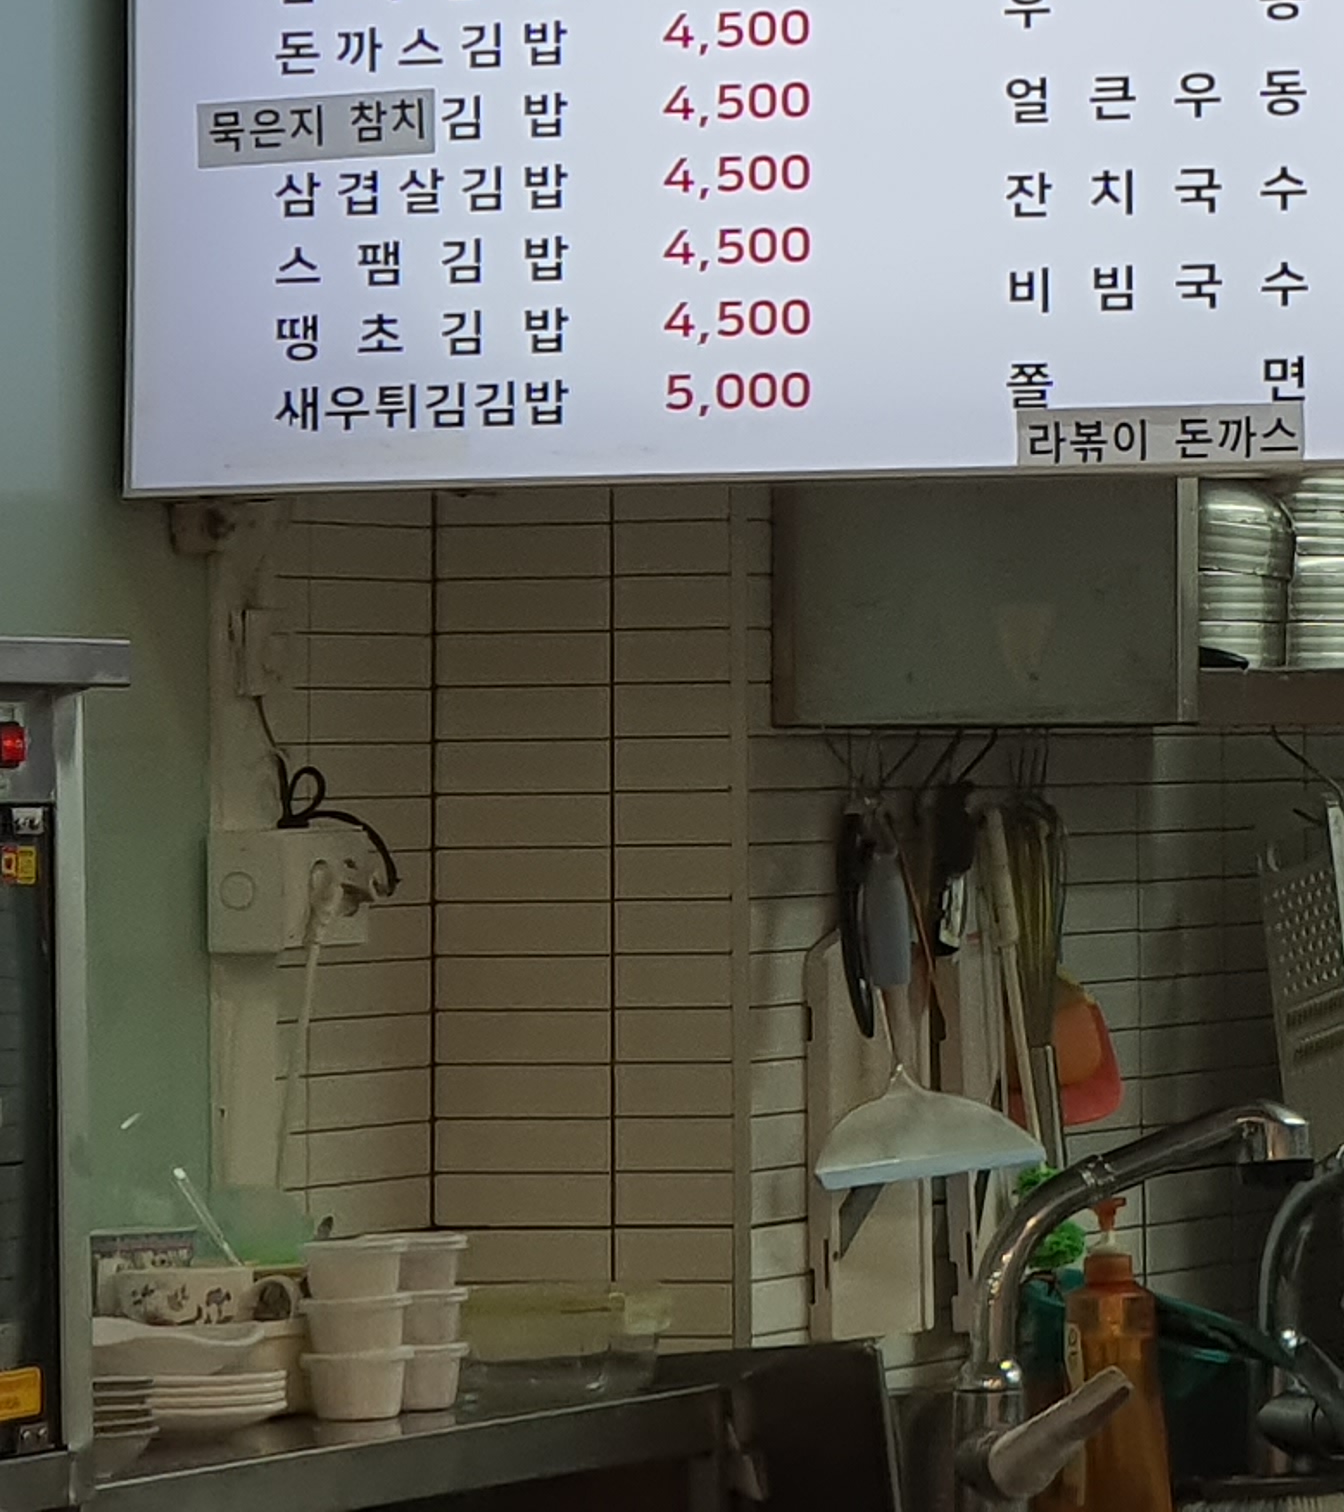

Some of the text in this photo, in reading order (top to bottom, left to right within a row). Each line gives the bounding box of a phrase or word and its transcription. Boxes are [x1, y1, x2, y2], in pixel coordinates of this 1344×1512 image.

[663, 10, 809, 56] 4,500
[207, 82, 810, 152] 묵은지 참치 김밥 4,500
[664, 154, 810, 200] 4,500
[663, 227, 810, 272] 4,500
[664, 299, 810, 345] 4,500
[275, 372, 810, 432] 새우튀김김밥 5,000
[1028, 419, 1148, 463] 라볶이
[1175, 416, 1299, 459] 돈까스
